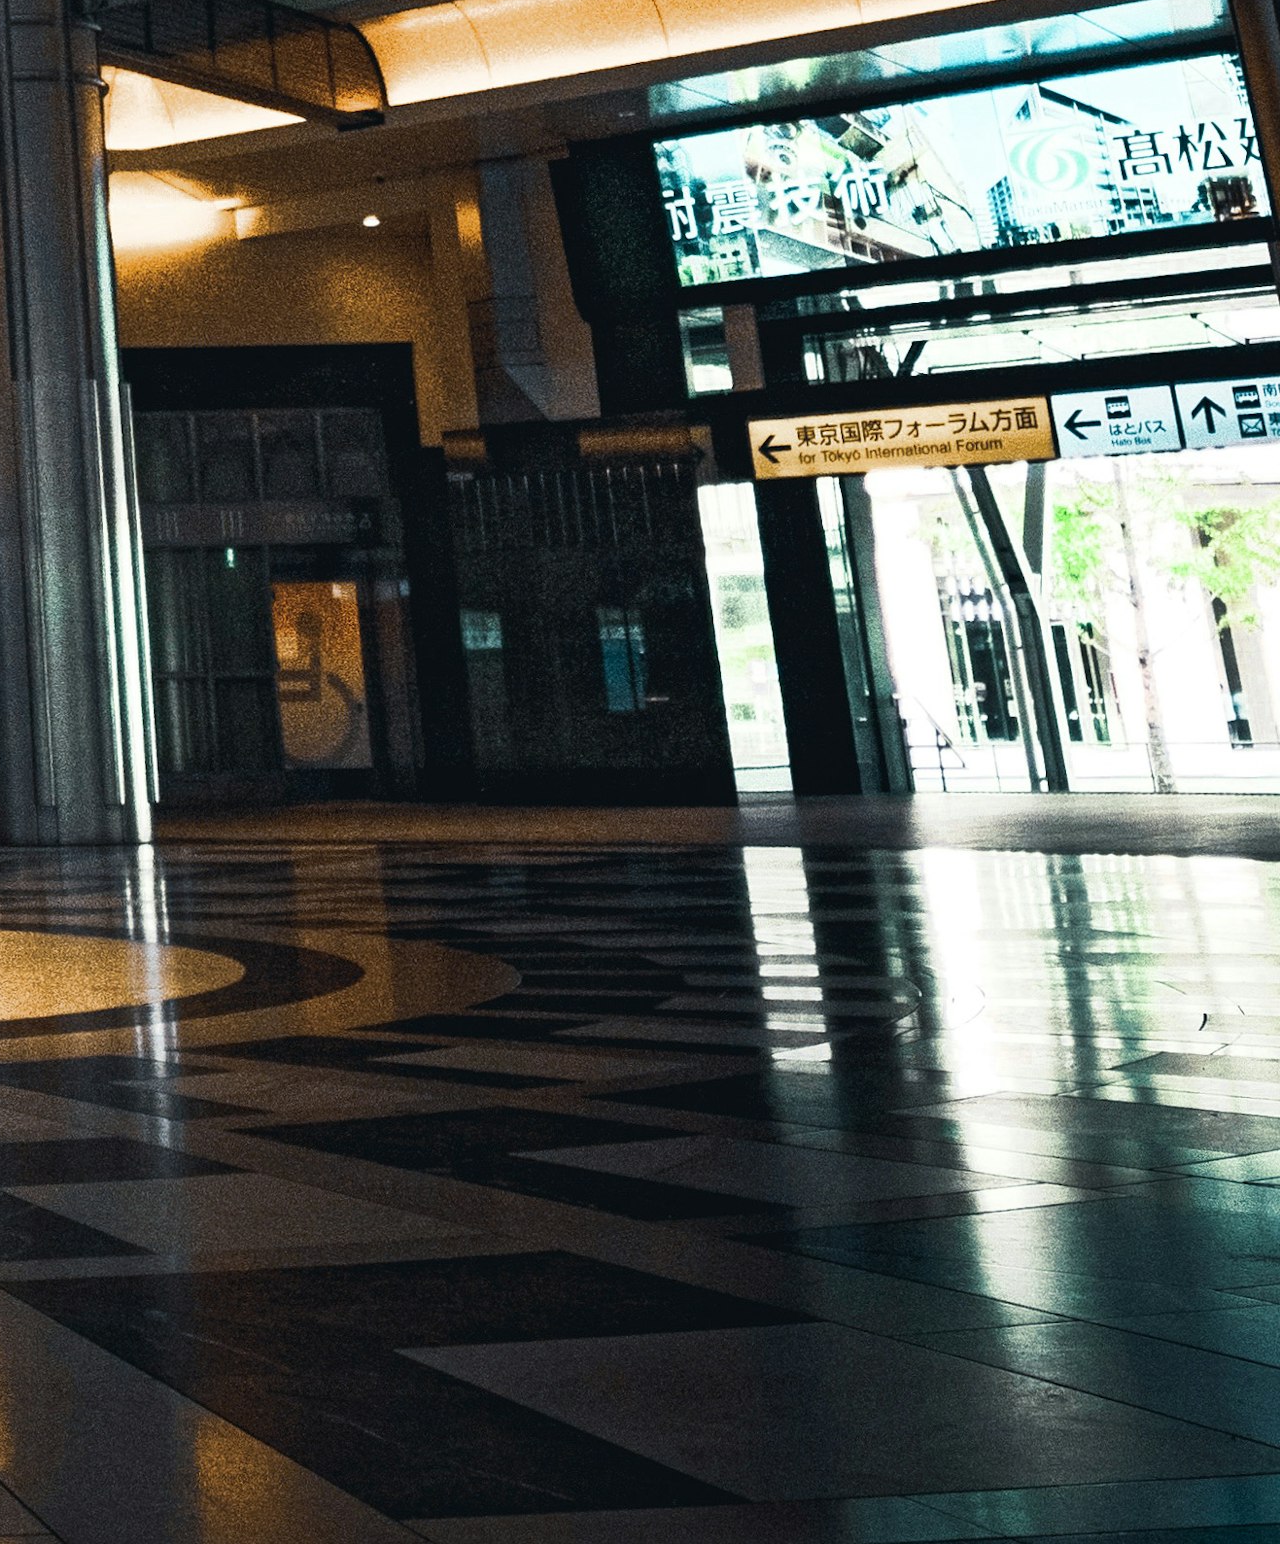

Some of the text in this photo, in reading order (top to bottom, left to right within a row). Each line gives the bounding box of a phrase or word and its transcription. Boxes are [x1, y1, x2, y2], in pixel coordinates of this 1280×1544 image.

[796, 405, 1039, 447] 東京国際フォーラム方面
[1109, 419, 1167, 436] はとバス
[798, 451, 817, 465] for
[865, 439, 952, 459] International
[957, 438, 1004, 453] Forum
